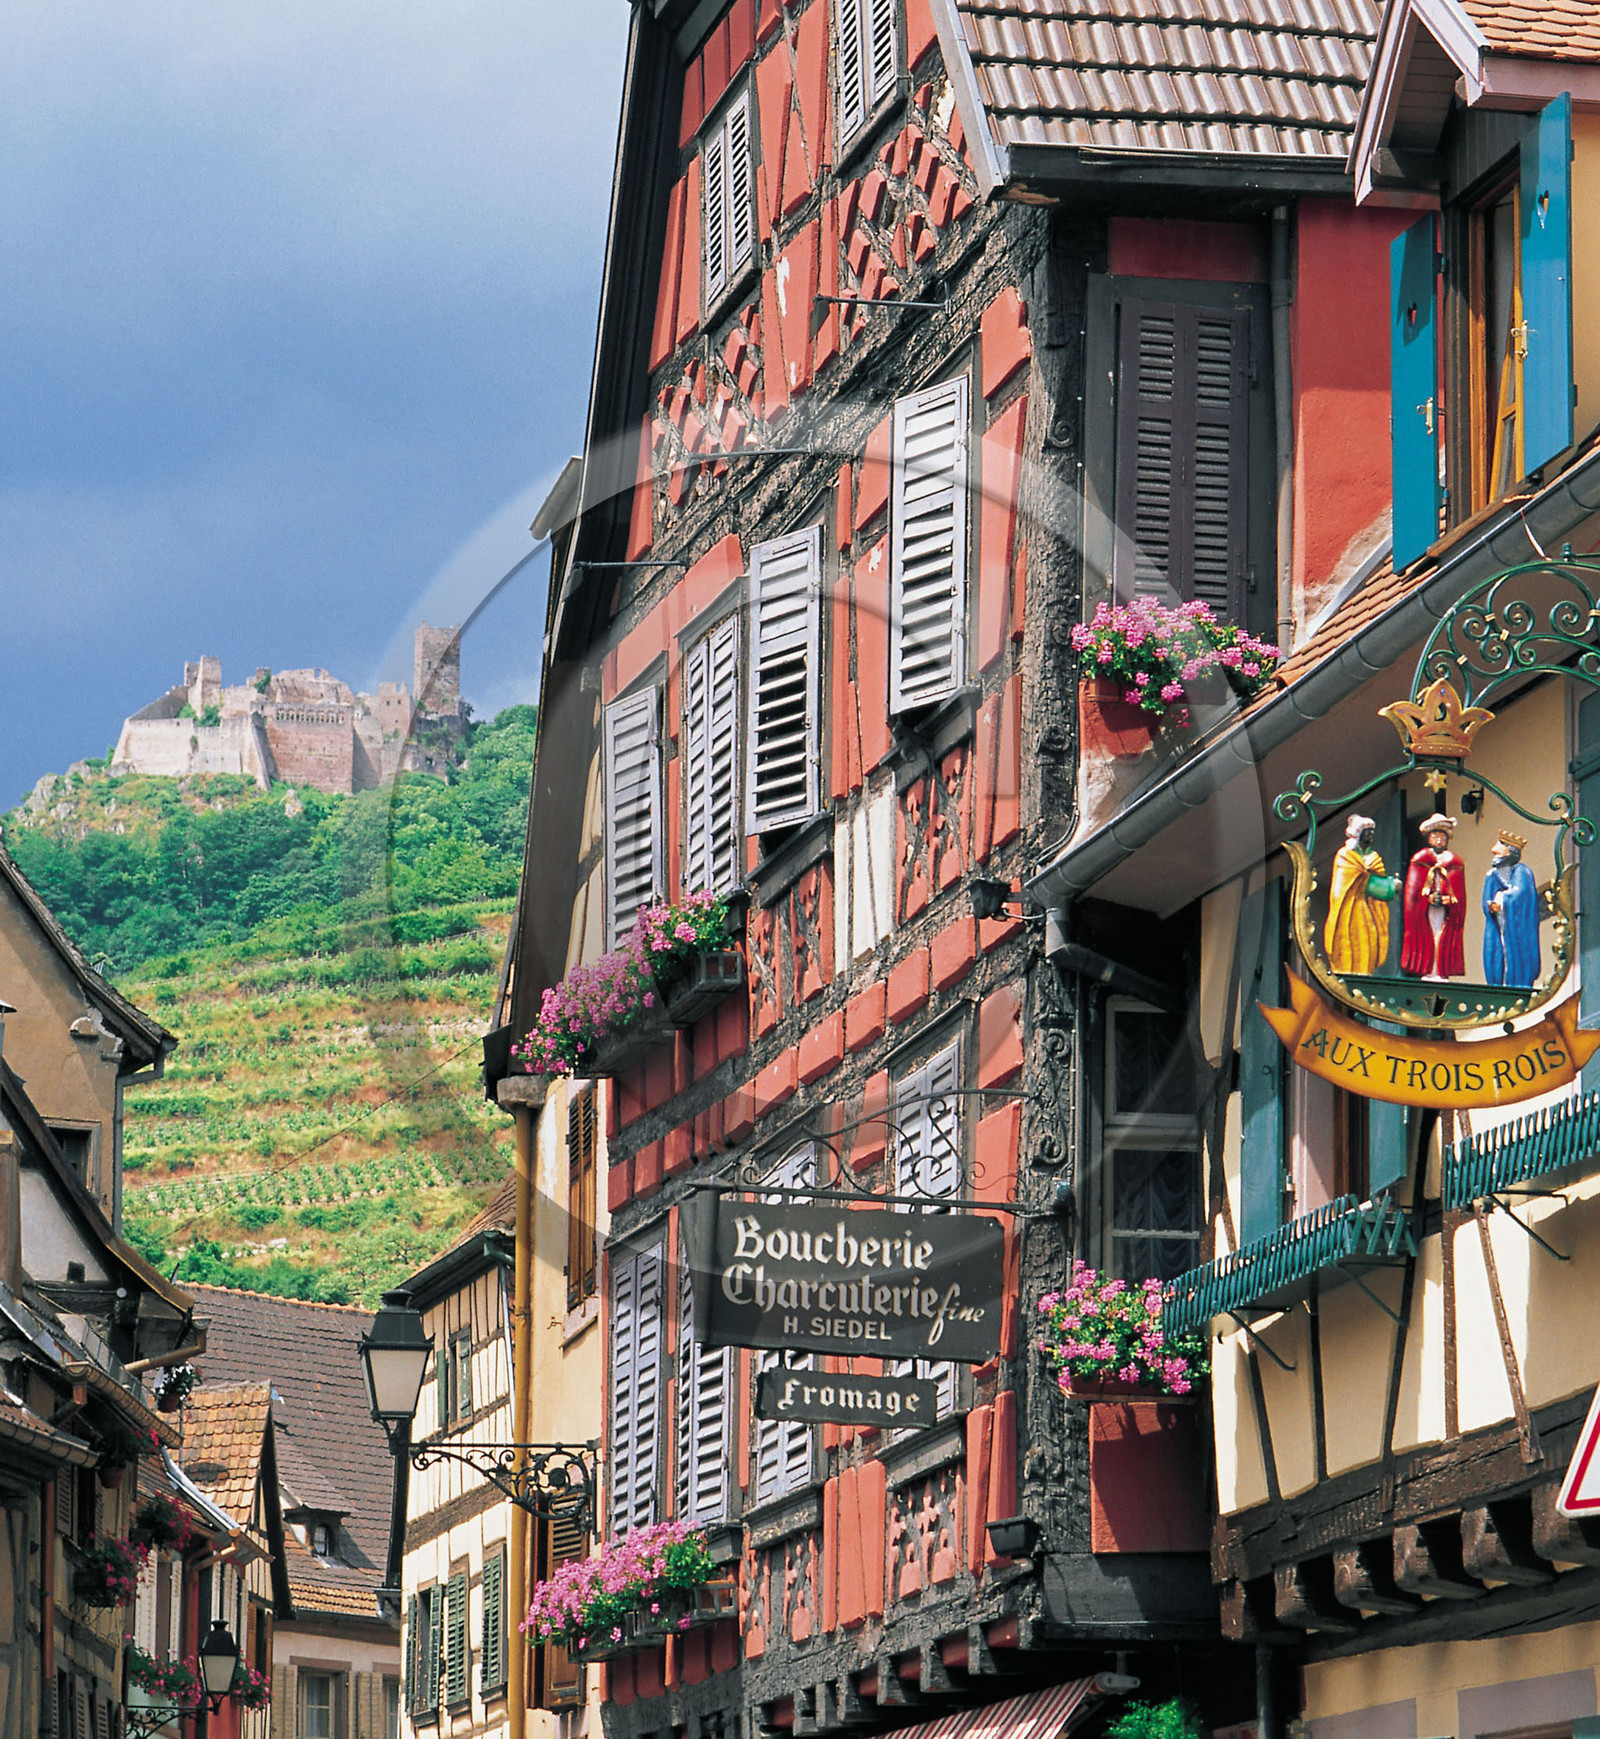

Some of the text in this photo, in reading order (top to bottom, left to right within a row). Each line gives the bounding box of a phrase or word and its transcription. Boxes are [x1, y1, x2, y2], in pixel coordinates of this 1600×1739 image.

[1301, 1027, 1567, 1092] AUX TROIS ROIS
[732, 1213, 934, 1271] Boucherie
[721, 1262, 986, 1346] Charcuterie fine
[783, 1315, 892, 1341] H. SIEDEL
[777, 1377, 921, 1416] Fromage
